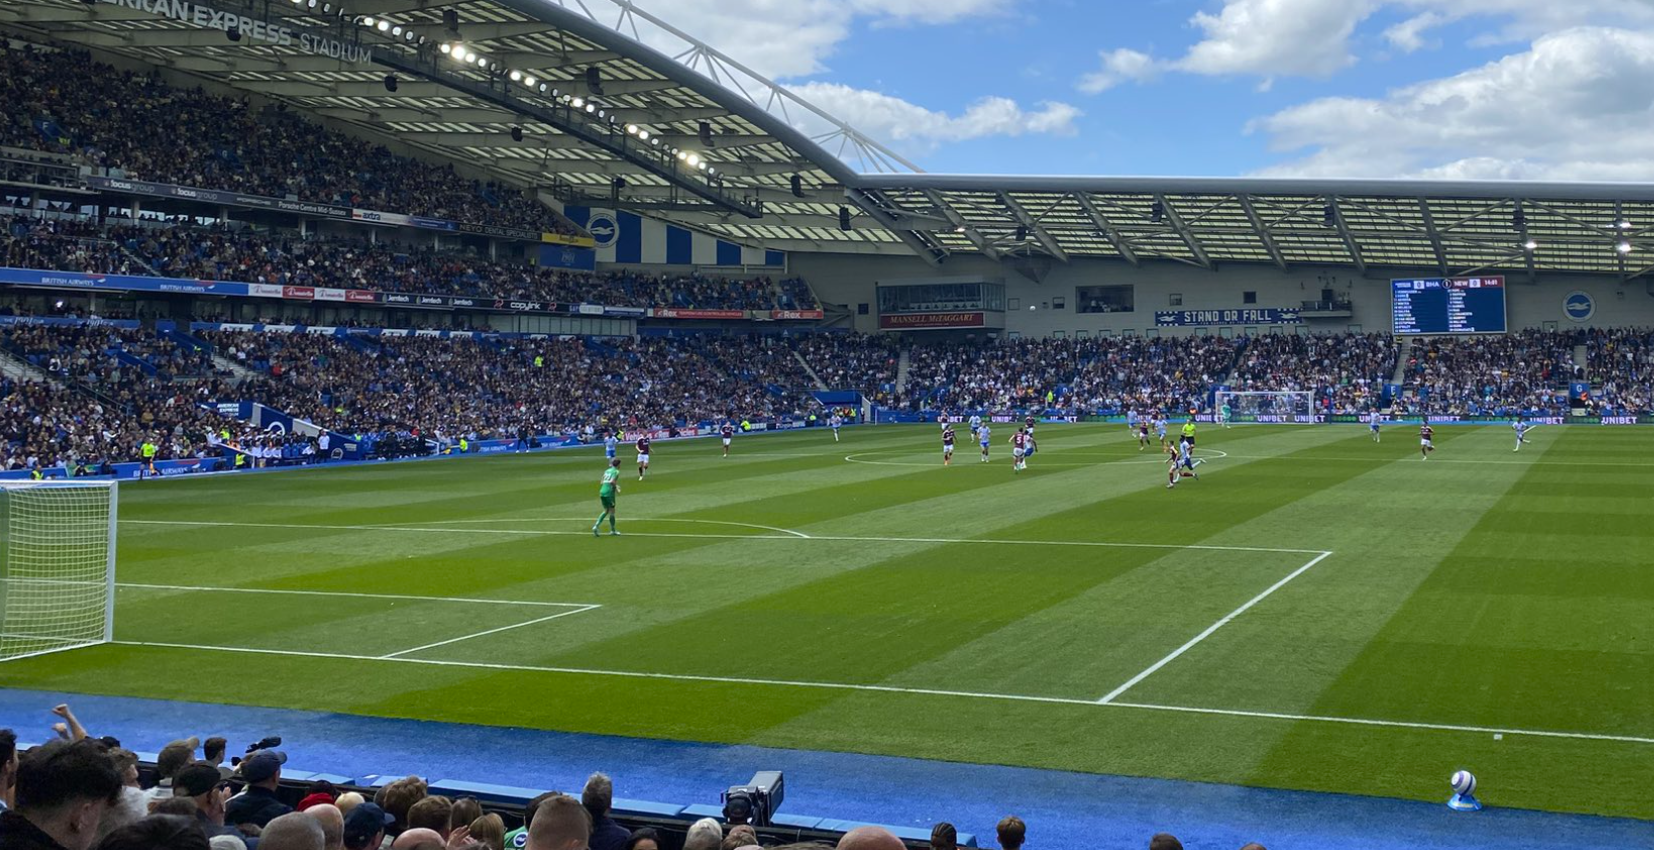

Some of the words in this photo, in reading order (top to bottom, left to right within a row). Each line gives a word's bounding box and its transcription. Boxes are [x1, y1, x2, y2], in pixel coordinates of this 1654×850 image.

[194, 4, 290, 46] EXPRESS
[300, 32, 372, 66] STADIUM
[484, 226, 506, 236] DENTAL
[506, 229, 538, 240] SPECIALISTS
[784, 310, 800, 318] Rex
[890, 316, 926, 324] MANSELL
[1184, 310, 1220, 322] STAND
[1224, 310, 1238, 321] OR
[1242, 310, 1272, 320] FALL
